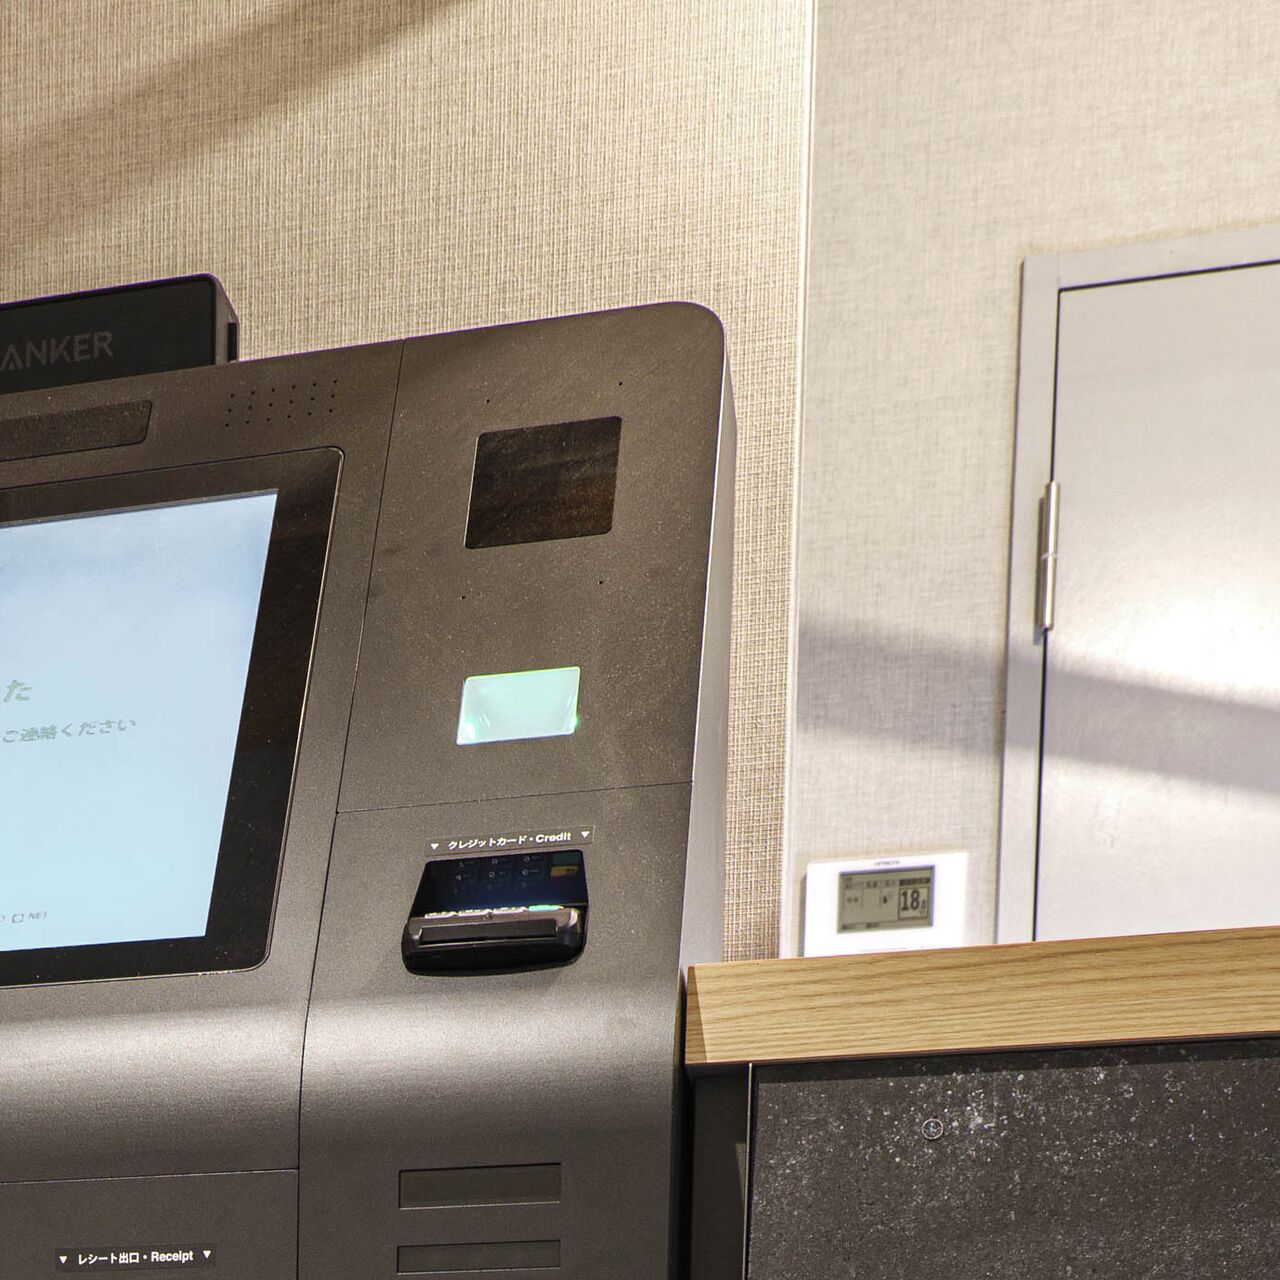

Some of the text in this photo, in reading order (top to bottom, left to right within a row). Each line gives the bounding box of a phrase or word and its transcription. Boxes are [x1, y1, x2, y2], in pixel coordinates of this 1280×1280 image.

[0, 331, 113, 372] ANKER
[447, 831, 572, 850] クレジットカード・Credit
[78, 1250, 194, 1265] レシート出口・Receipt
